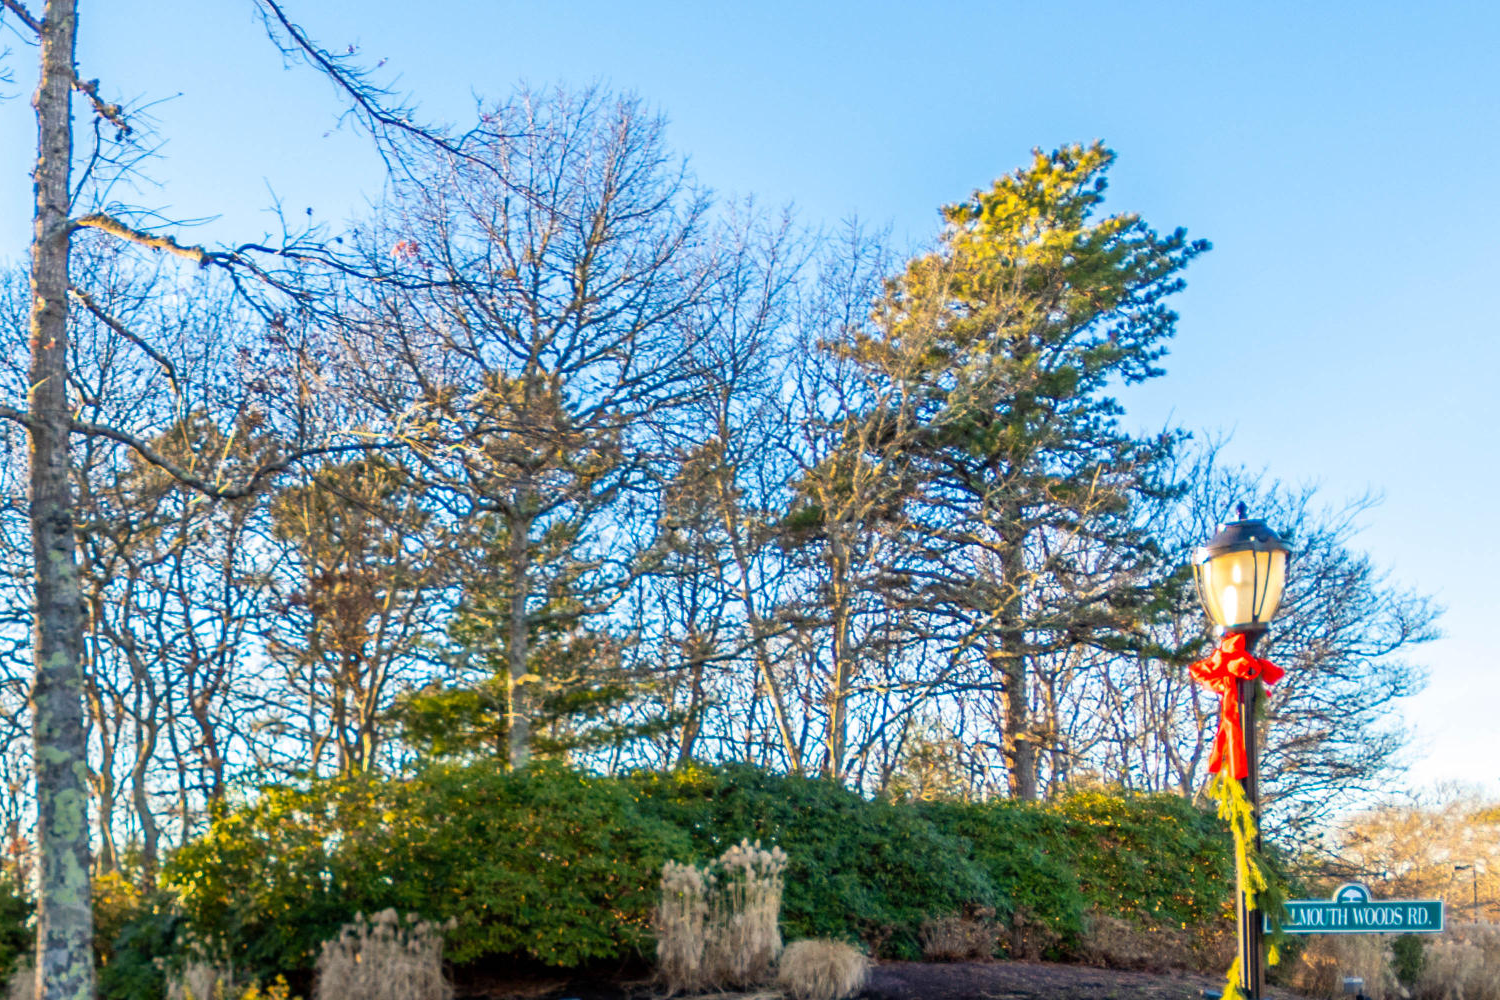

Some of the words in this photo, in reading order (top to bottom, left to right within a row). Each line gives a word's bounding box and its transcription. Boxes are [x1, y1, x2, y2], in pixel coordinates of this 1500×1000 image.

[1280, 907, 1348, 926] LMOUTH
[1352, 907, 1403, 926] WOODS
[1407, 907, 1432, 926] RD.
